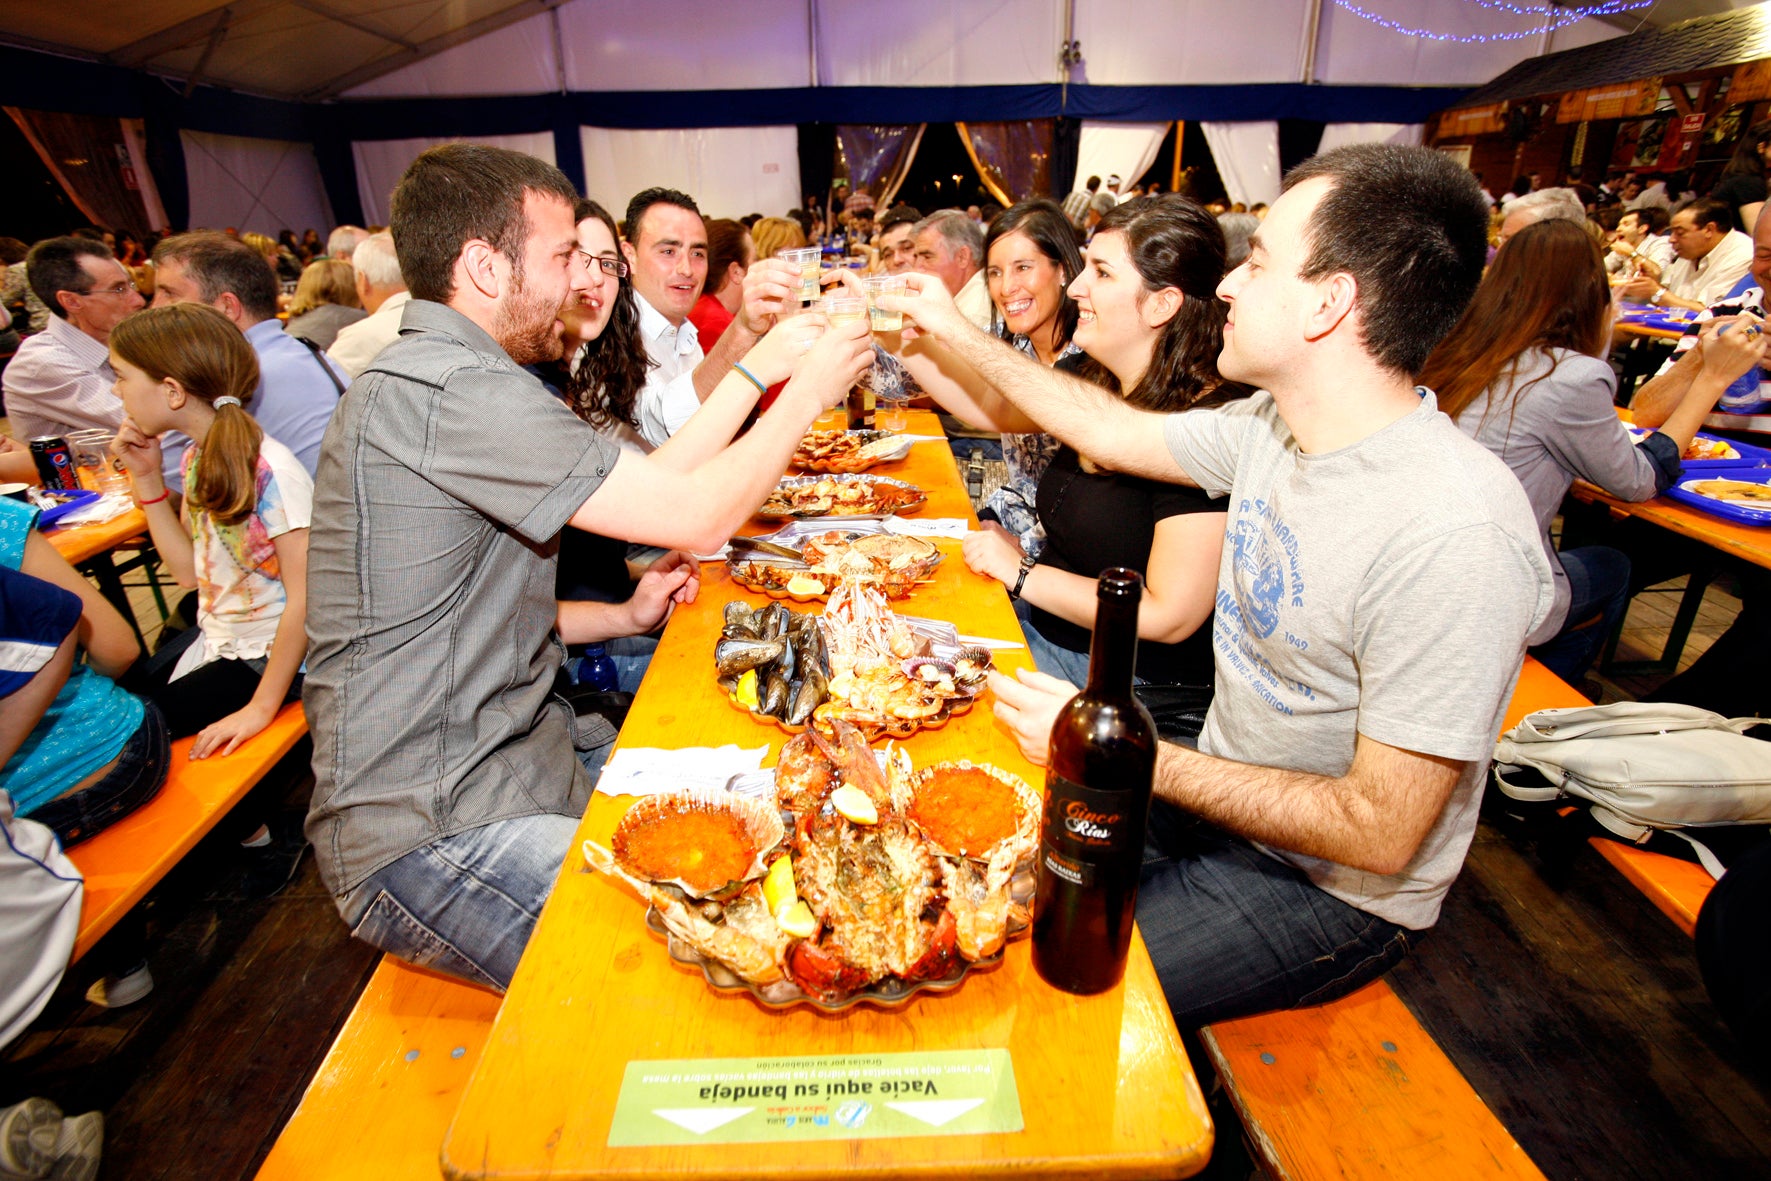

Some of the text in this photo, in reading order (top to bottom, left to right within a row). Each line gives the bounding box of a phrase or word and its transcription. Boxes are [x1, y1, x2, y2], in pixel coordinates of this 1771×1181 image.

[1284, 631, 1308, 651] 1949
[1220, 641, 1230, 653] IN
[1060, 799, 1120, 824] Cinco
[756, 1057, 882, 1070] Gracias por su colaboración
[974, 1064, 991, 1074] Por
[747, 1071, 791, 1083] bandejas
[794, 1071, 808, 1082] las
[810, 1070, 816, 1081] y
[818, 1070, 846, 1080] vidrio
[848, 1069, 860, 1079] de
[863, 1068, 901, 1079] botellas
[904, 1067, 919, 1078] las
[642, 1075, 669, 1085] mesa
[672, 1075, 682, 1085] la
[684, 1074, 712, 1084] sobre
[698, 1079, 938, 1103] Vacíe aquí su bandeja
